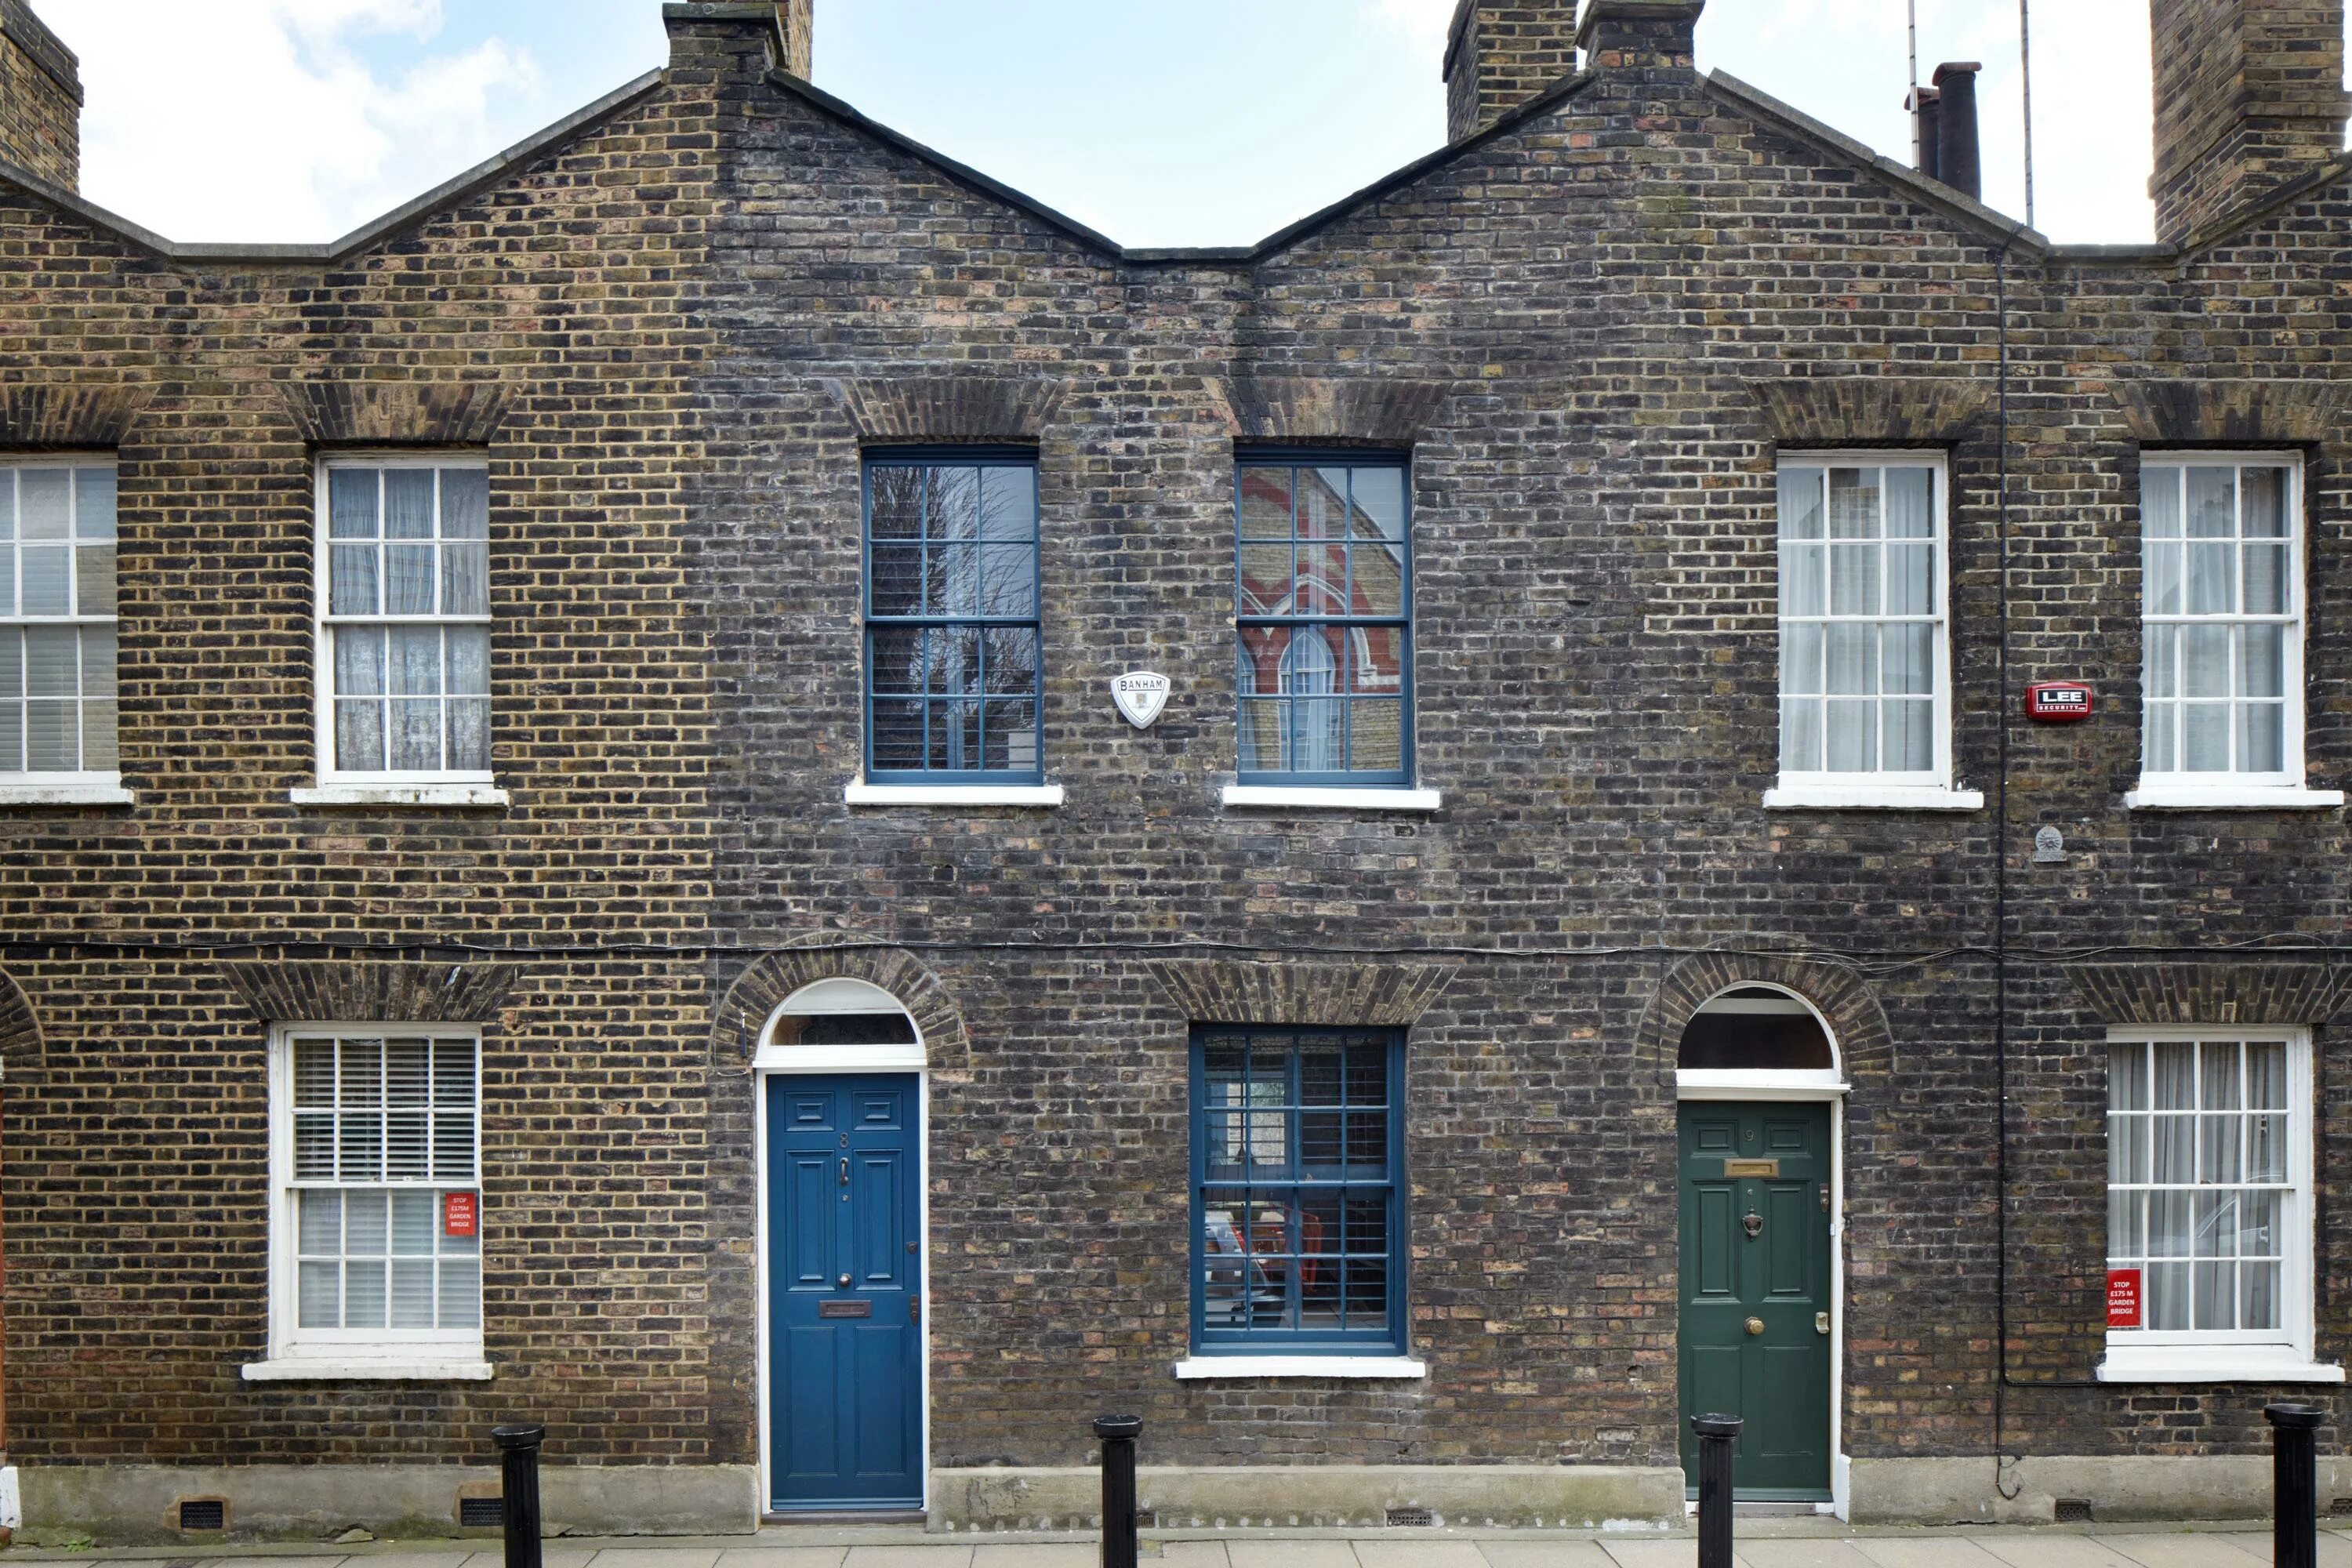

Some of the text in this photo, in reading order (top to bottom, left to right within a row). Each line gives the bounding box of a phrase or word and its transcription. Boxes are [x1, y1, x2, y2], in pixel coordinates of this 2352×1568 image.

[1120, 681, 1163, 691] BANHAM
[2042, 691, 2082, 702] LEE
[1746, 1129, 1754, 1142] 9
